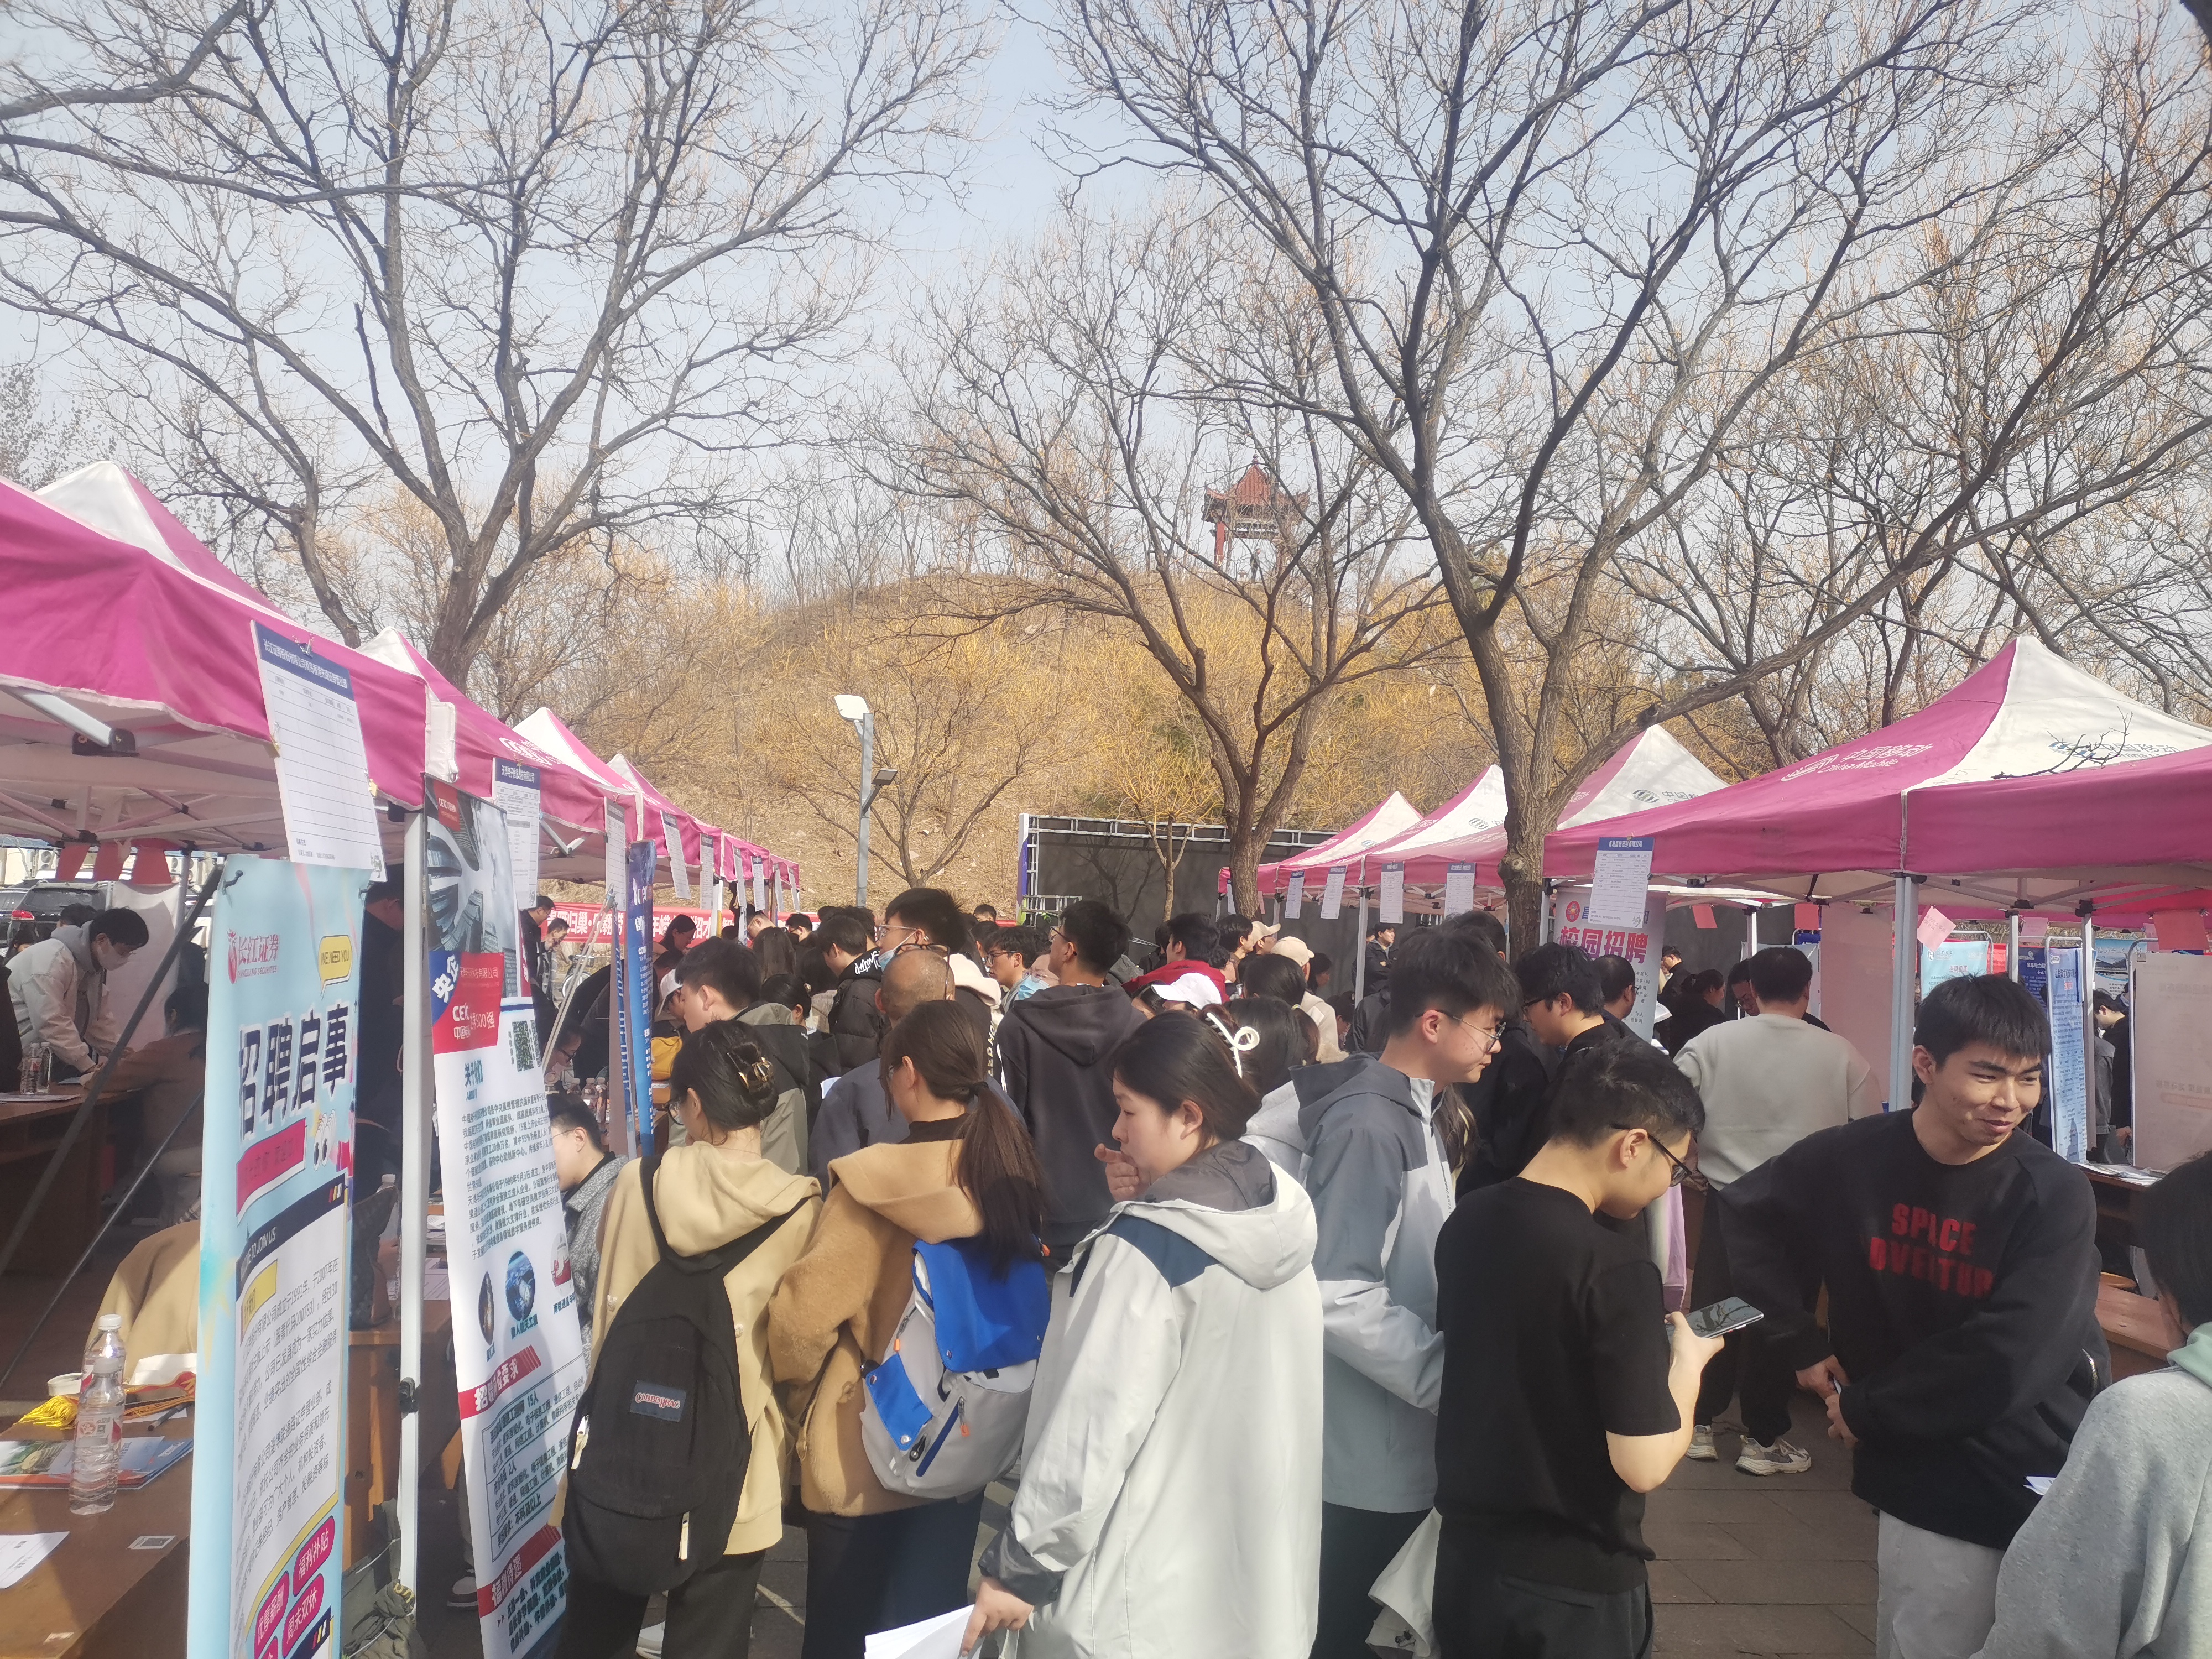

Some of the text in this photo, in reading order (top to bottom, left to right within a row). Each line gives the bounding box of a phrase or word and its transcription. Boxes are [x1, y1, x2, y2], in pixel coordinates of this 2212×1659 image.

[1817, 758, 1900, 774] China Mobile
[1841, 743, 1934, 762] 中国移动
[238, 933, 279, 966] 长江证券
[321, 949, 349, 965] WE NEED YOU
[1559, 926, 1648, 964] 校园招聘
[432, 954, 459, 1003] 央企
[238, 1003, 349, 1141] 招聘启事
[298, 1528, 330, 1581] 福利补贴
[491, 1553, 523, 1606] 福利待遇
[286, 1587, 318, 1645] 周末双休
